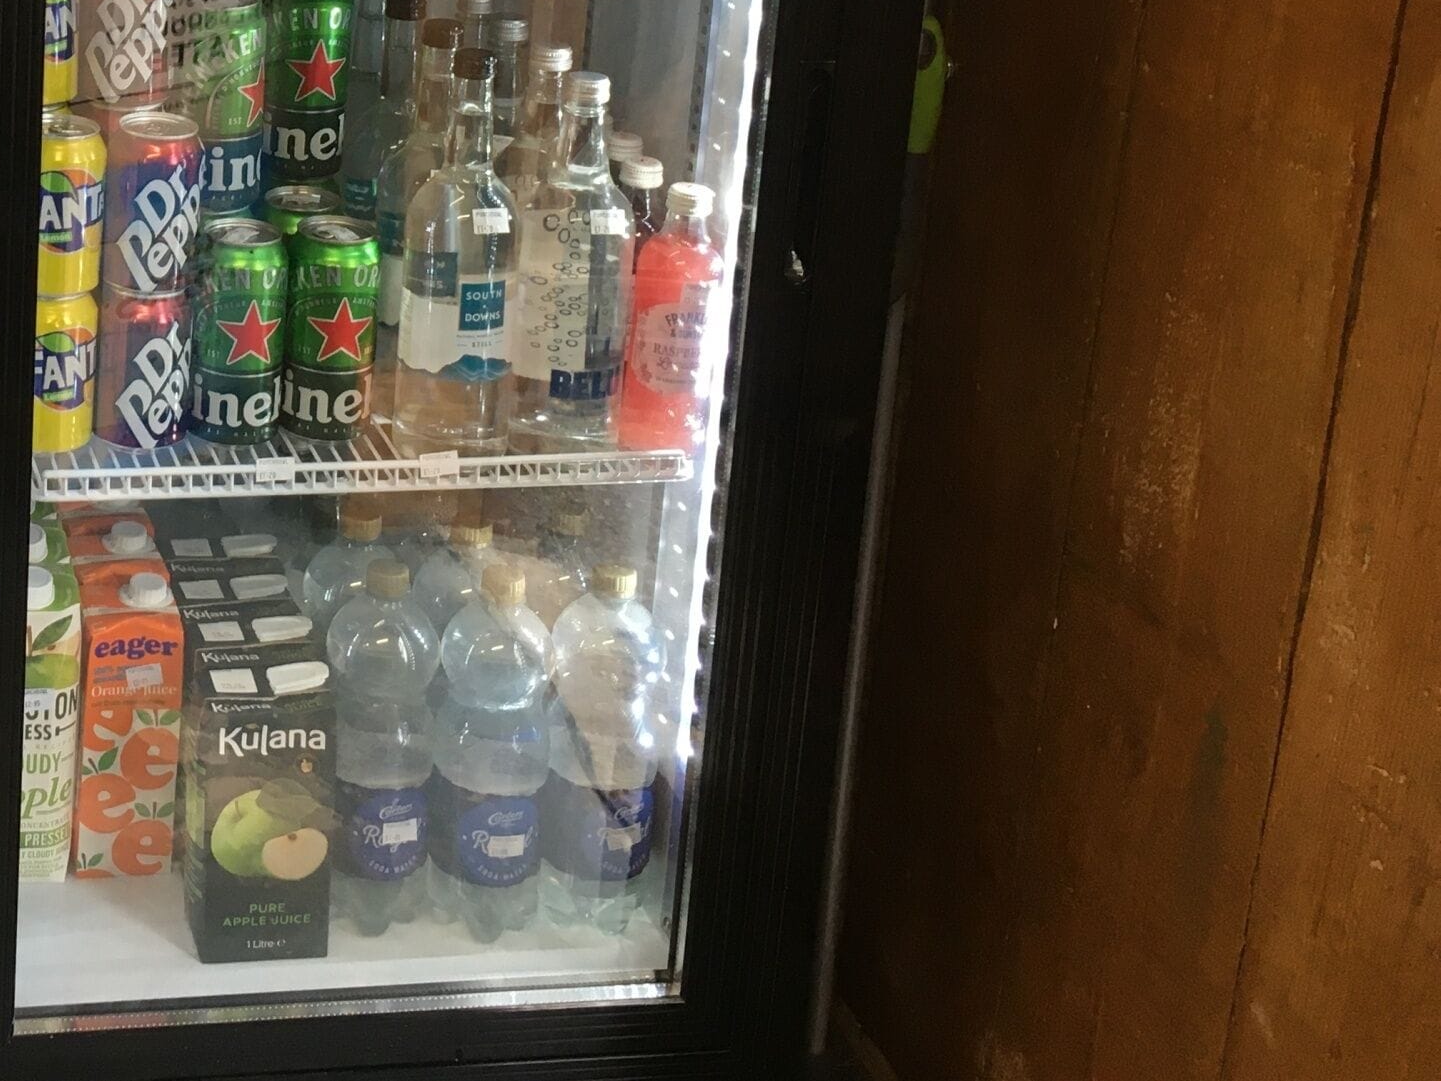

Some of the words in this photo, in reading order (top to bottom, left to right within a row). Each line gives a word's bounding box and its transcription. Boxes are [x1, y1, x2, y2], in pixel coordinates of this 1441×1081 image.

[465, 289, 503, 301] SOUTH
[464, 310, 502, 322] DOWNS
[133, 321, 191, 380] Dr
[182, 608, 240, 621] Kulana
[94, 636, 179, 660] eager
[201, 651, 261, 663] Kulana
[211, 702, 272, 714] Kulana
[218, 723, 327, 758] Kulana
[249, 903, 286, 915] PURE
[223, 913, 266, 928] APPLE
[270, 912, 312, 926] JUICE
